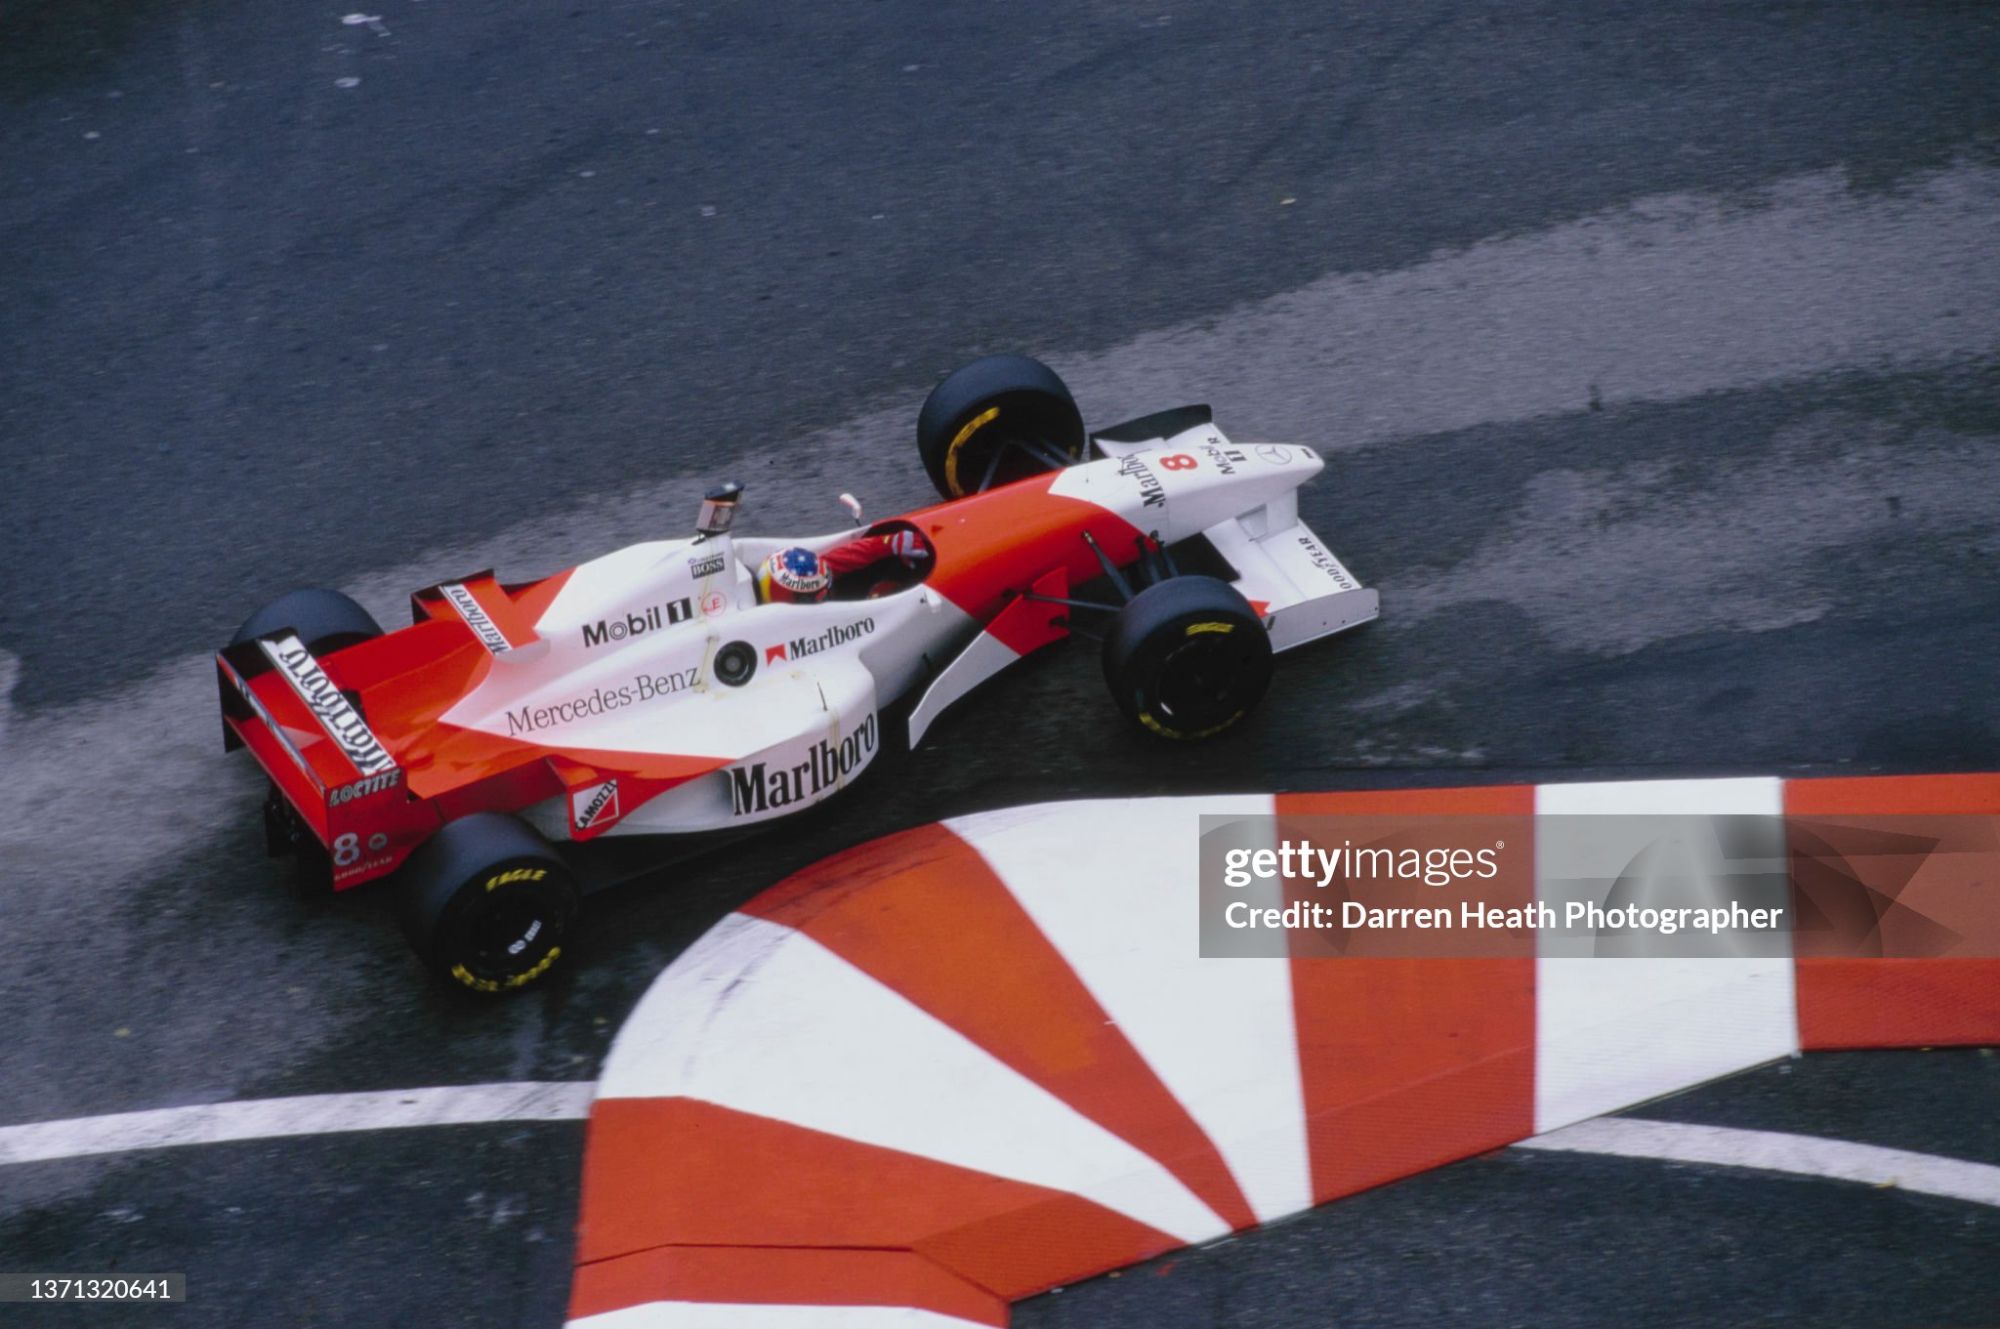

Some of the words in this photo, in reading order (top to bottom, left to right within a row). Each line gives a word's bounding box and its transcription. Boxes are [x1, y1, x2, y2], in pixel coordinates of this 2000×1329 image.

[1159, 454, 1198, 471] 8
[692, 558, 724, 578] BOSS
[582, 606, 662, 648] Mobil
[668, 598, 690, 624] 1
[789, 617, 875, 661] Marlboro
[506, 667, 701, 736] Mercedes-Benz
[731, 713, 875, 816] Marlboro
[329, 767, 402, 807] LOCTITE
[333, 832, 360, 867] 8
